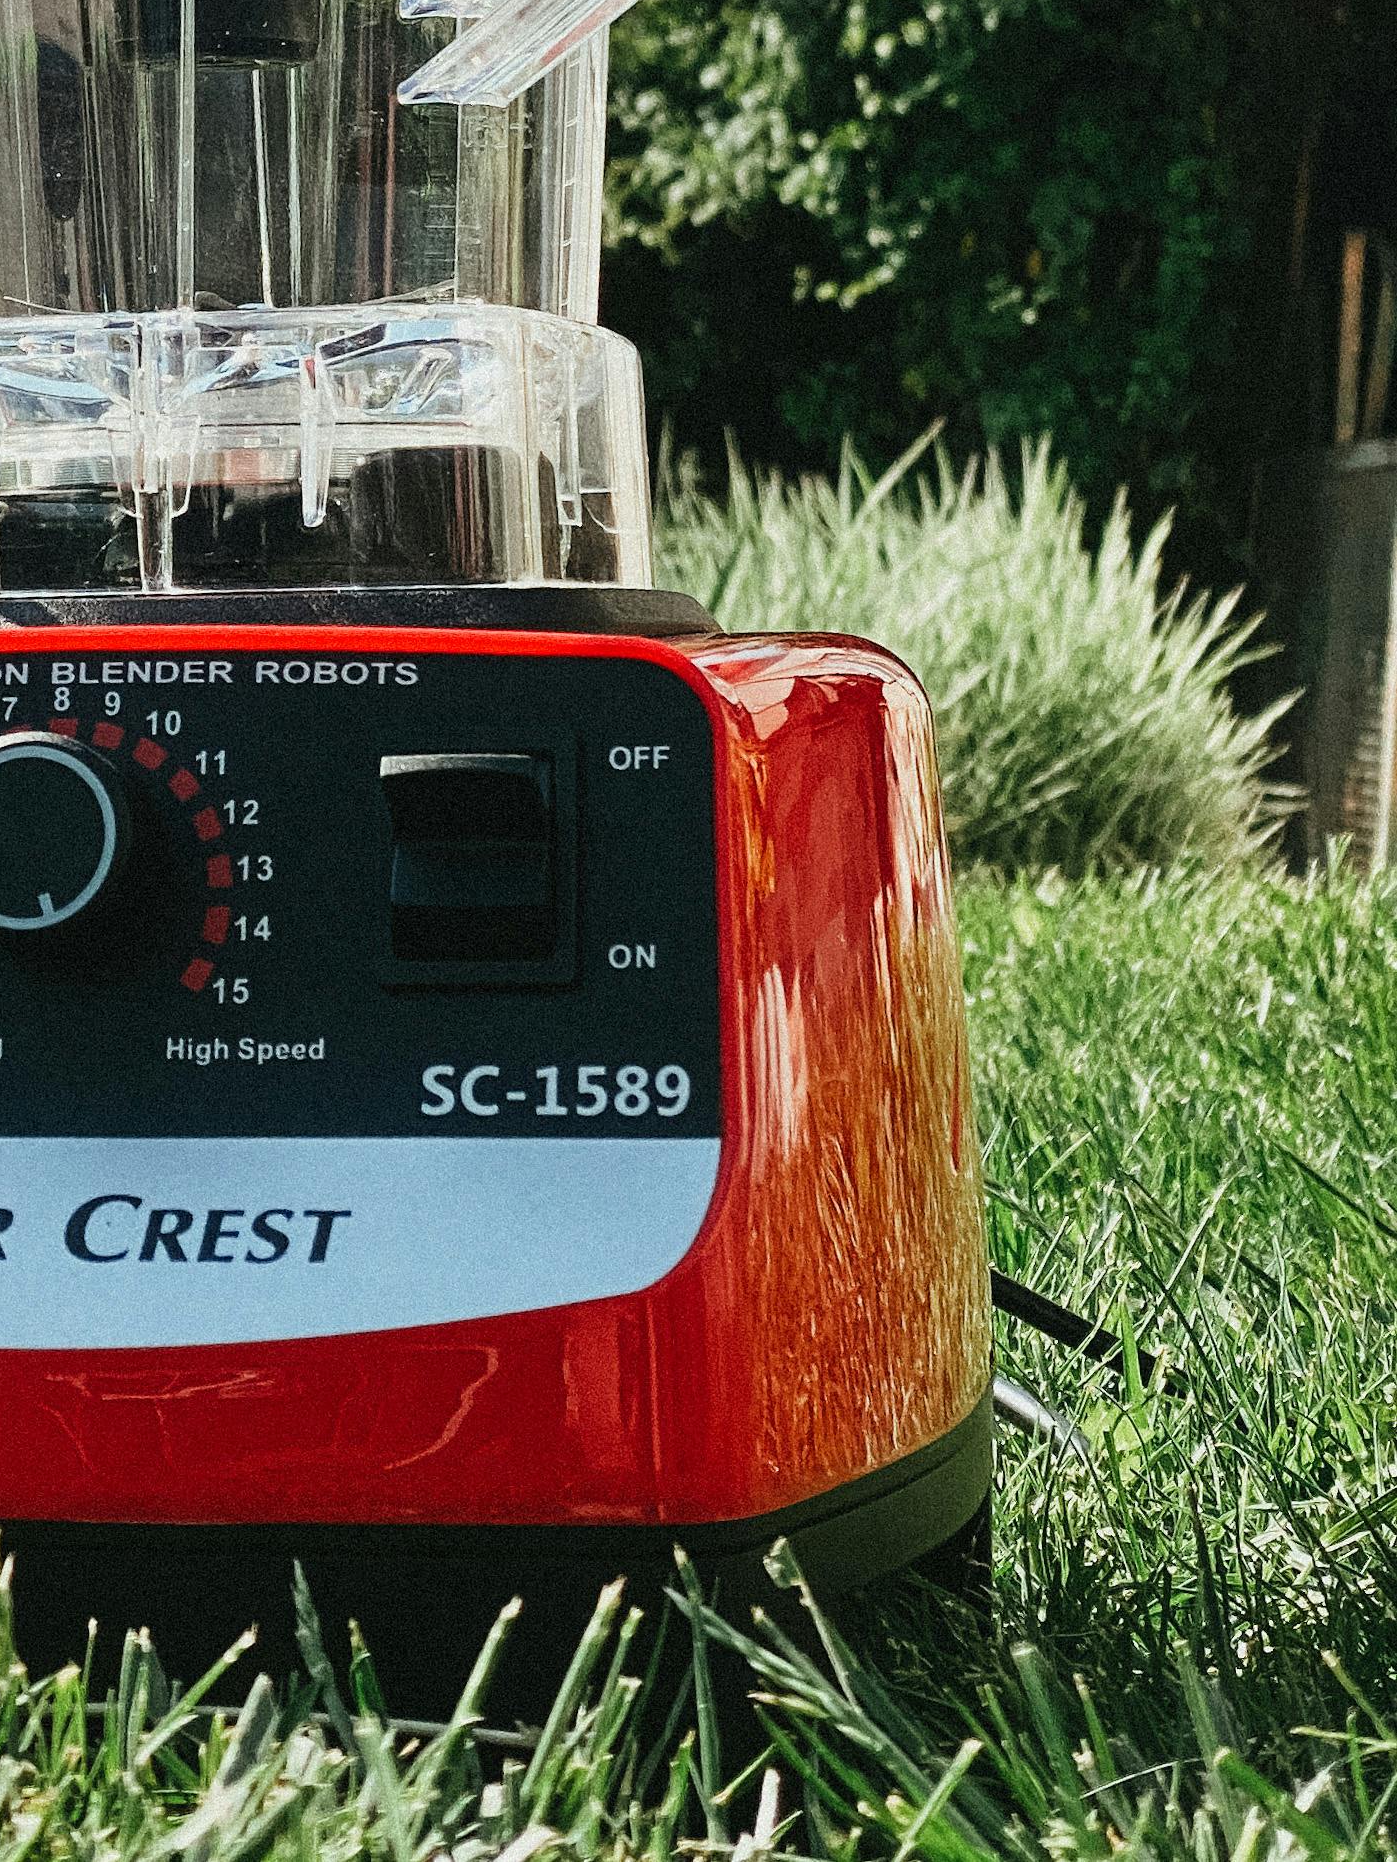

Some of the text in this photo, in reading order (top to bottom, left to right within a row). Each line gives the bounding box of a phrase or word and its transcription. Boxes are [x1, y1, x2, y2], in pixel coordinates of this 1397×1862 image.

[51, 660, 233, 685] BLENDER
[255, 660, 418, 686] ROBOTS
[2, 697, 18, 721] 7
[53, 686, 70, 712] 8
[104, 691, 121, 716] 9
[147, 710, 182, 736] 10
[195, 750, 226, 775] 11
[608, 745, 670, 771] OFF
[224, 799, 259, 825] 12
[239, 856, 273, 881] 13
[235, 916, 271, 941] 14
[608, 944, 656, 969] ON
[213, 978, 249, 1004] 15
[166, 1037, 325, 1066] High Speed
[421, 1065, 690, 1117] SC-1589
[64, 1194, 352, 1264] CREST
